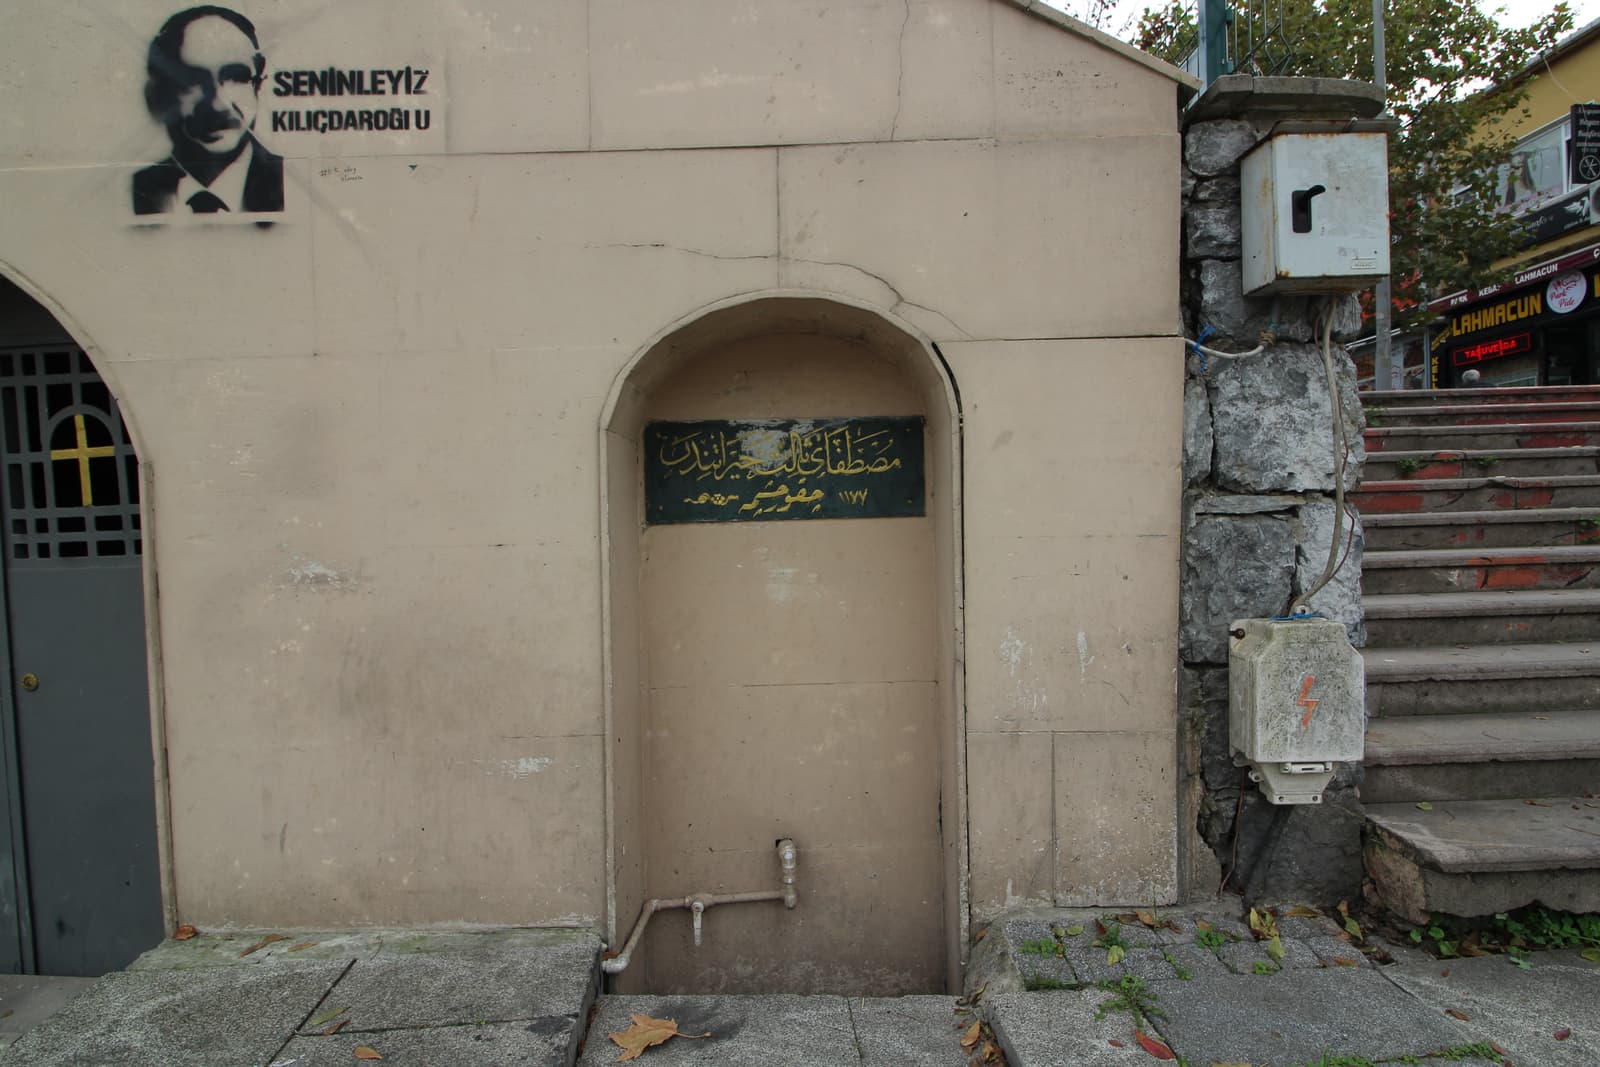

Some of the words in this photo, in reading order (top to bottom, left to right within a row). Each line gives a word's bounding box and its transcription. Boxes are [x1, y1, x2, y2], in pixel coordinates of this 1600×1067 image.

[273, 66, 430, 97] SENİNLEYİZ
[1514, 263, 1558, 285] LAHMACUN
[1452, 293, 1542, 337] LAHMACUN
